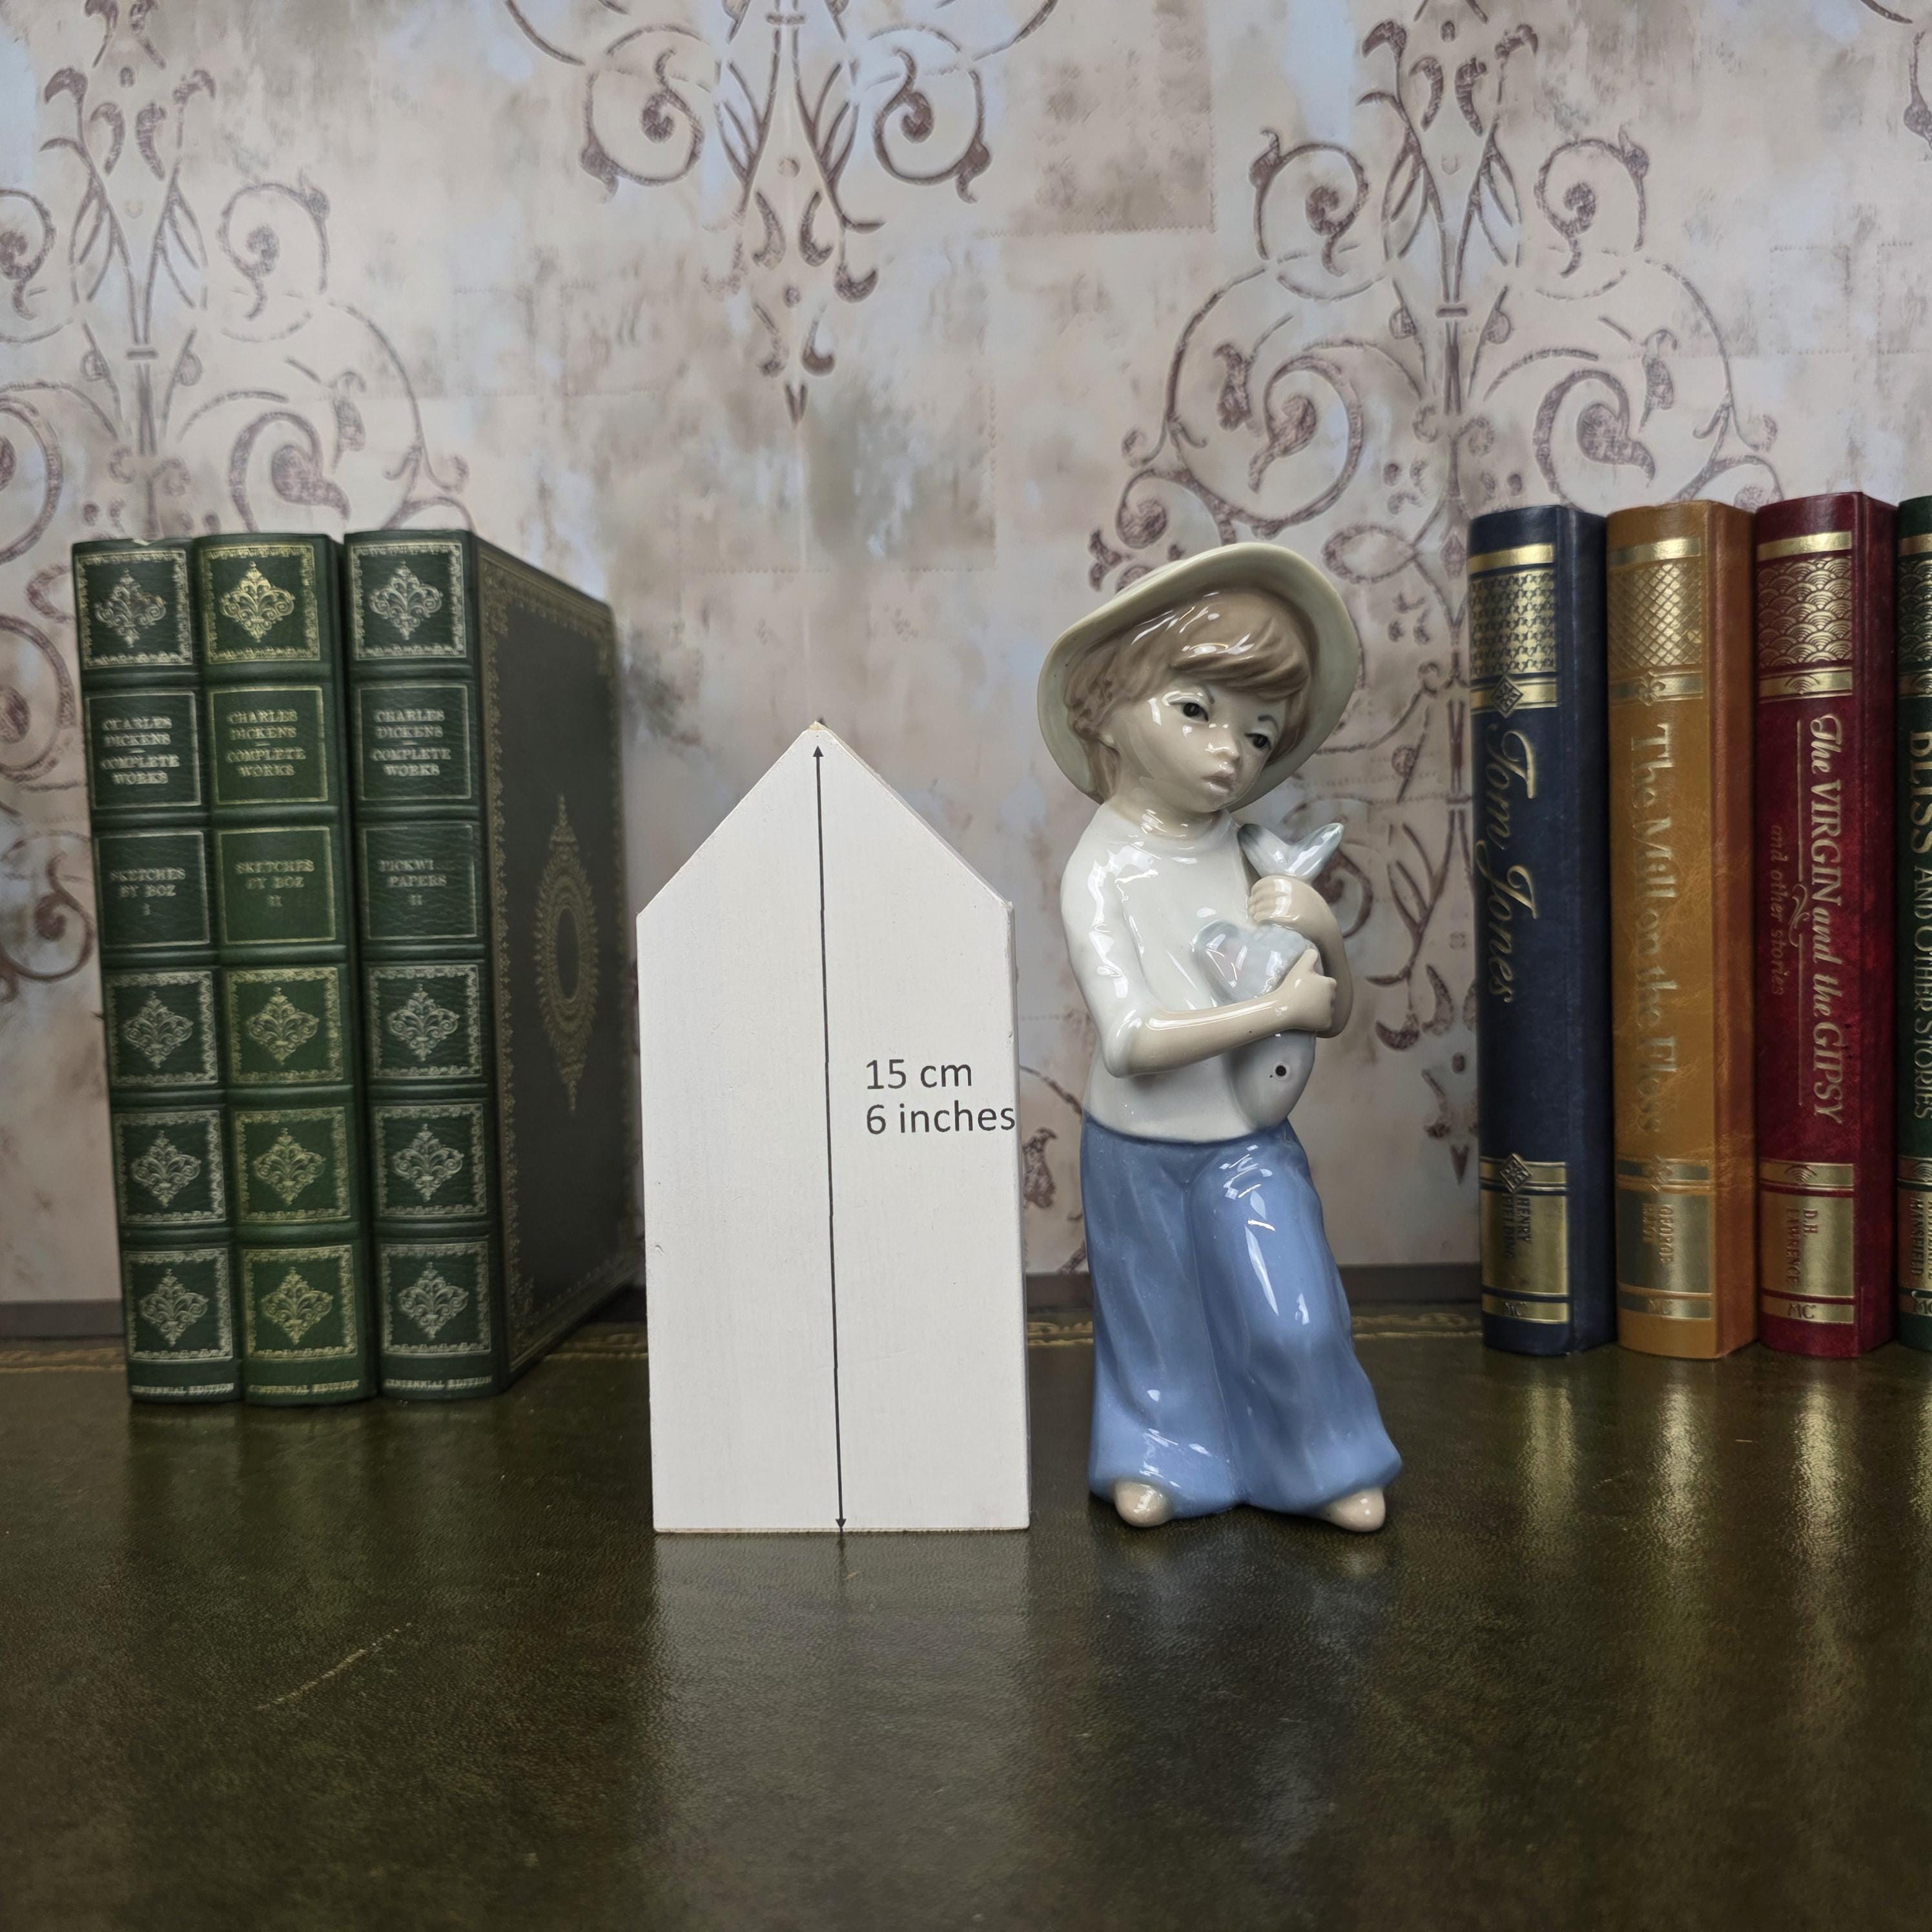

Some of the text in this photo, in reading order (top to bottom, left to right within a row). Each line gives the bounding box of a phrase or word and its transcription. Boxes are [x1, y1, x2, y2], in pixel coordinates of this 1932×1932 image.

[227, 709, 298, 724] CHARLES
[374, 708, 445, 723] CHARLES
[375, 724, 444, 739] DICKENS
[101, 754, 180, 770] COMPLETE
[226, 746, 306, 763] COMPLETE
[370, 746, 451, 761] COMPLETE
[1630, 723, 1675, 808] The
[237, 763, 295, 777] WORKS
[382, 763, 440, 777] WORKS
[1475, 724, 1539, 1003] Tom Jones
[1632, 815, 1678, 899] Mill
[387, 874, 447, 888] PAPERS
[1771, 825, 1790, 995] and other stories
[1810, 713, 1843, 1124] The VIRGIN and the GIPSY
[1909, 730, 1932, 1120] BLISS AND OTHER STORIES
[1636, 909, 1660, 956] on
[1637, 965, 1678, 1028] the
[866, 1059, 972, 1089] 15 cm
[867, 1100, 1016, 1135] 6 inches
[1786, 1208, 1801, 1284] LAWRENCE
[1787, 1302, 1817, 1319] MC
